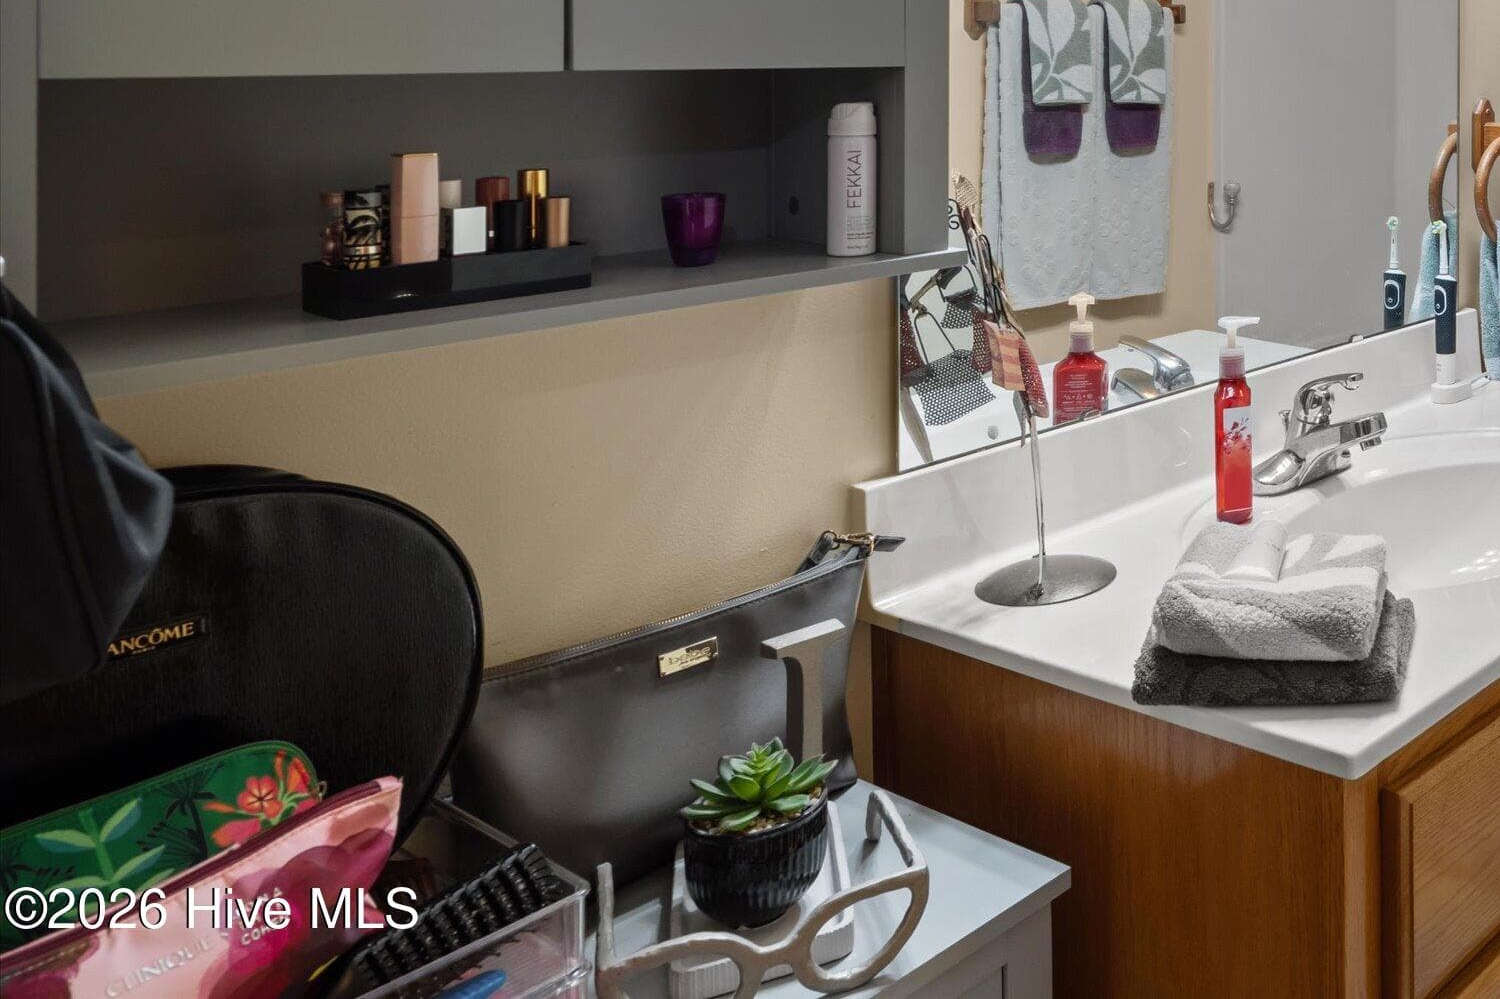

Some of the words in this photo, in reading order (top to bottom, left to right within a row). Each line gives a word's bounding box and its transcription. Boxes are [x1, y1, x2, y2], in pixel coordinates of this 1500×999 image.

[846, 150, 862, 208] FEKKAI
[106, 621, 195, 656] ANCÔME
[105, 935, 215, 998] CLINIQUE
